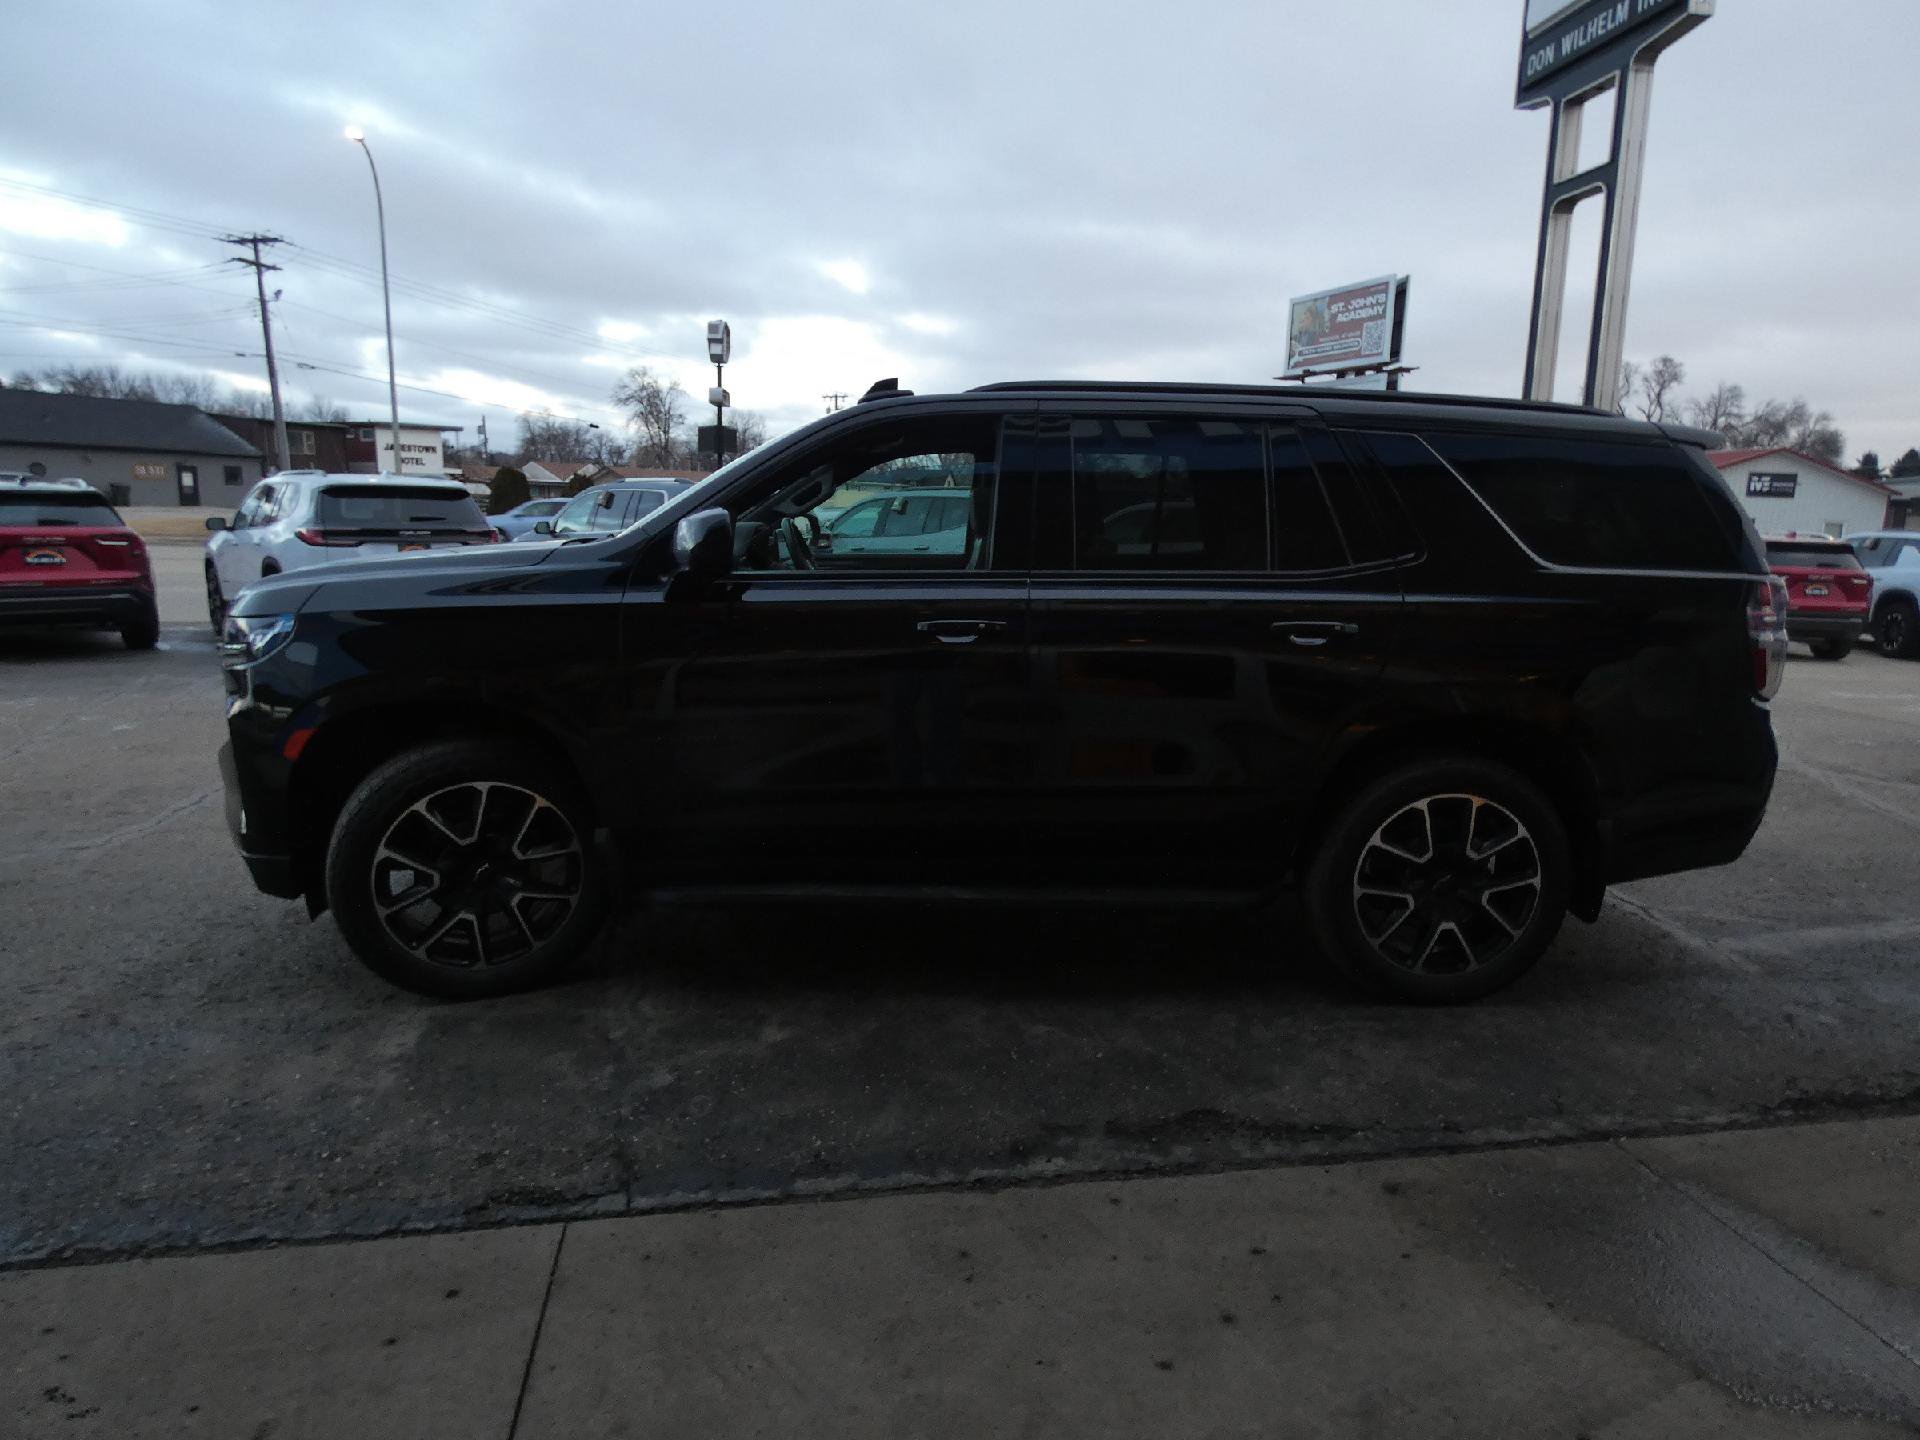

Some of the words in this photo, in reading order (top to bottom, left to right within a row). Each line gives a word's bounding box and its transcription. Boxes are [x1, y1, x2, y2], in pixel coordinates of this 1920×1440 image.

[1527, 42, 1555, 76] DON
[1561, 0, 1630, 57] WILHELM
[1638, 0, 1662, 13] IN
[1348, 293, 1387, 310] JOHN'S
[1336, 304, 1385, 322] ACADEMY
[384, 443, 437, 454] JAESTOWN
